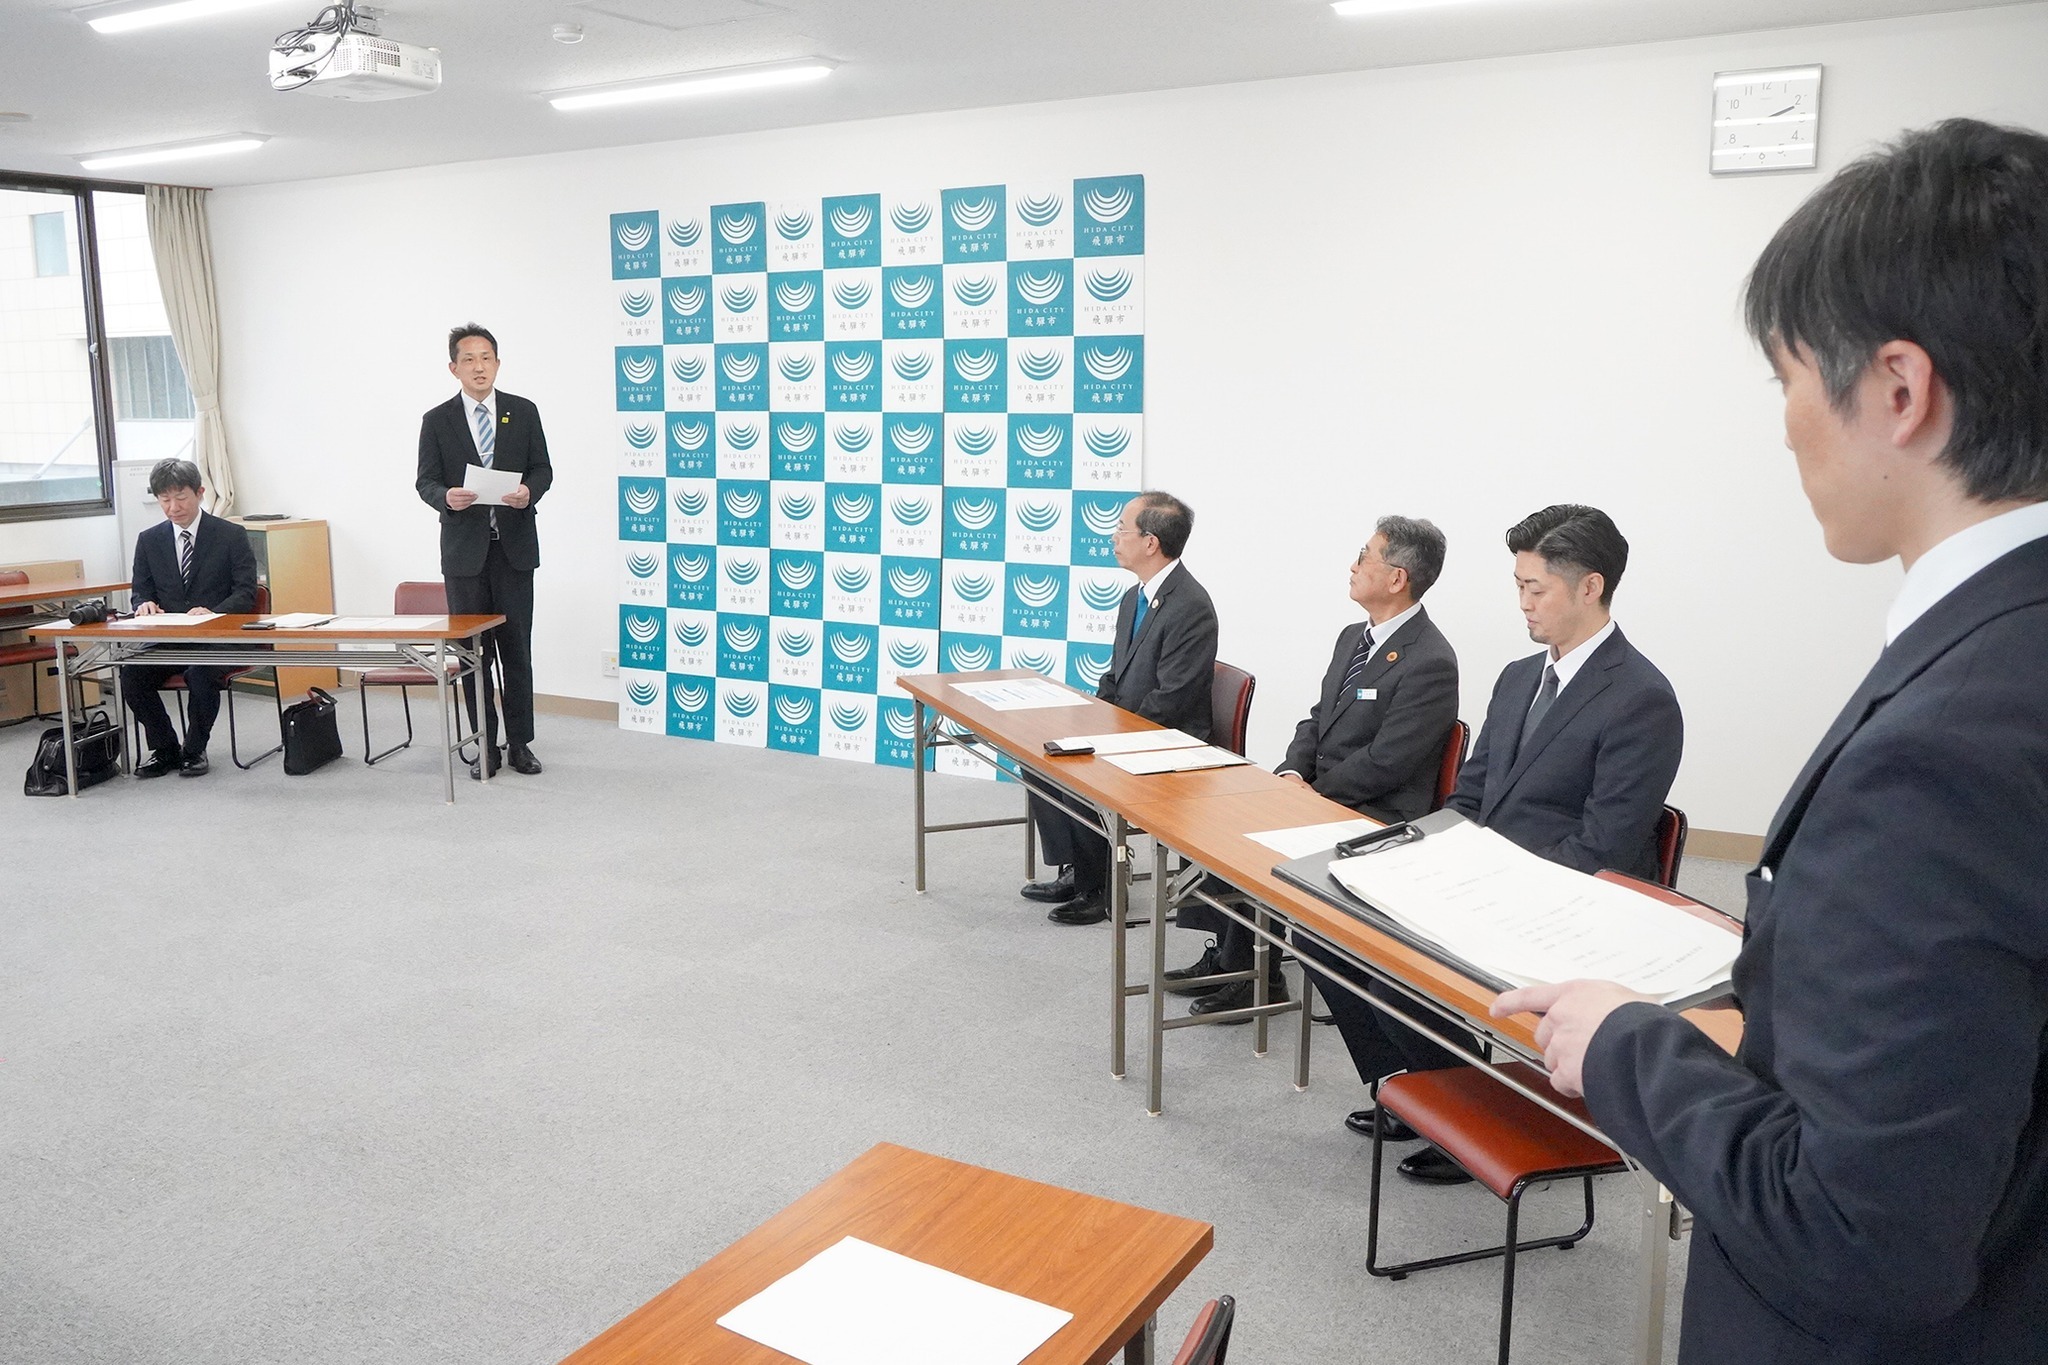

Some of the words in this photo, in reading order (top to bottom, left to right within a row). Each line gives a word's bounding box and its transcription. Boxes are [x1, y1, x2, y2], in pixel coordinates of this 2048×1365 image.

[1744, 85, 1753, 96] 11
[1730, 98, 1740, 110] 10
[1794, 94, 1802, 106] 2
[1729, 133, 1736, 144] 8
[1791, 129, 1799, 141] 4
[1083, 226, 1108, 234] HIDA
[1080, 537, 1104, 545] HIDA
[775, 725, 793, 733] HIDA
[883, 739, 904, 748] HIDA
